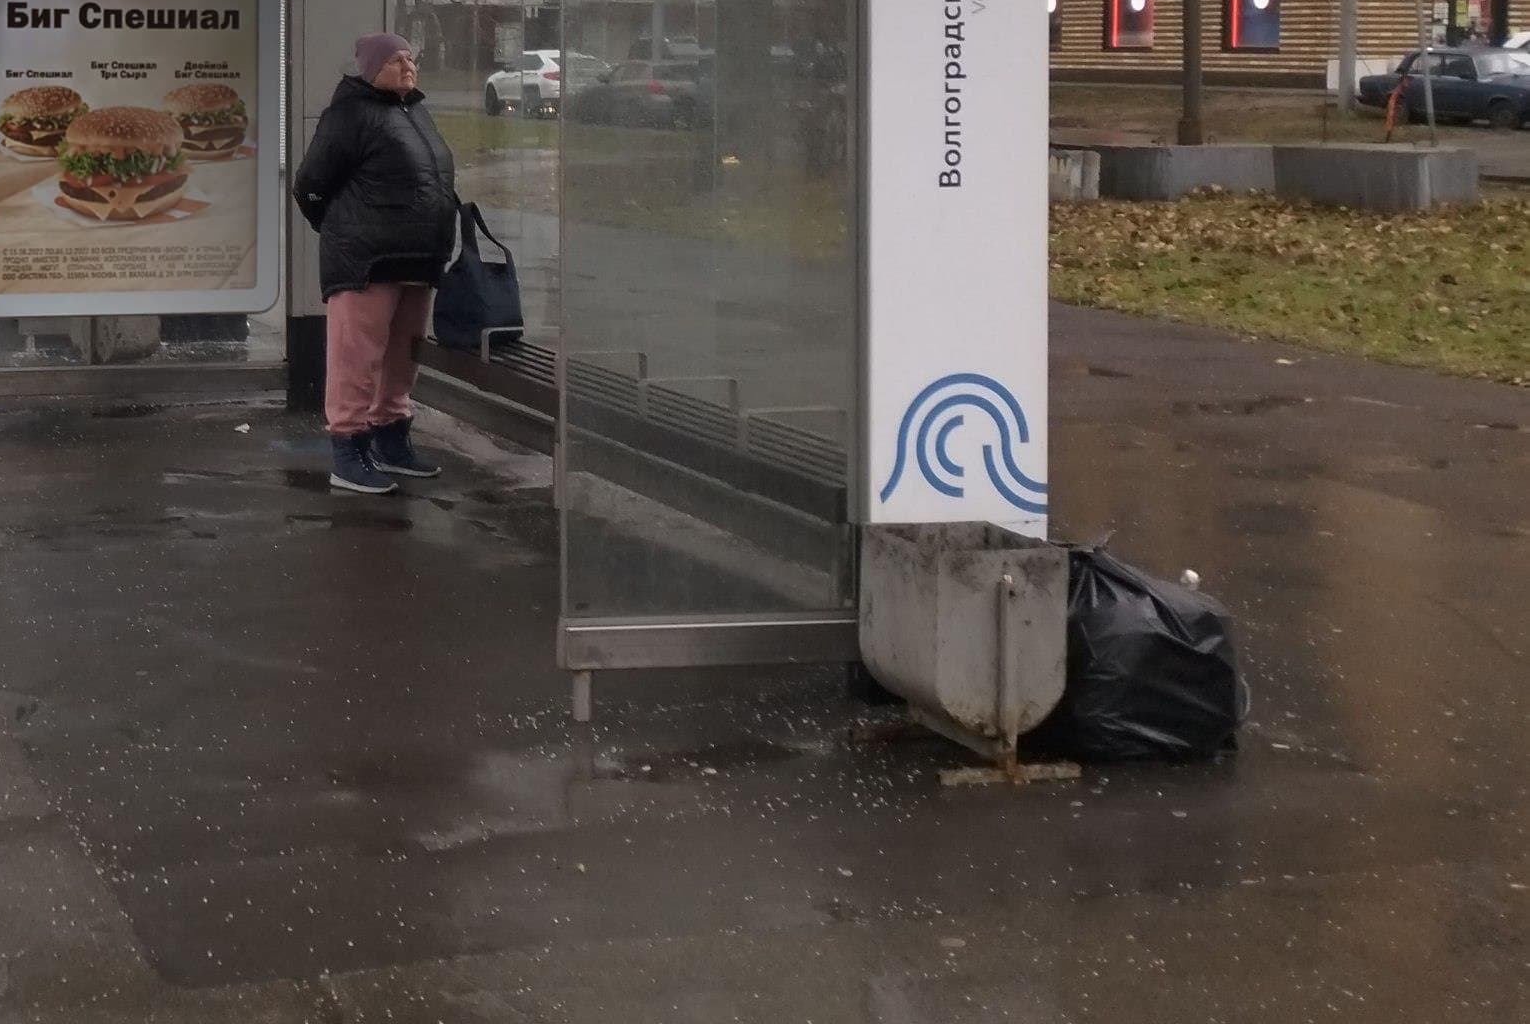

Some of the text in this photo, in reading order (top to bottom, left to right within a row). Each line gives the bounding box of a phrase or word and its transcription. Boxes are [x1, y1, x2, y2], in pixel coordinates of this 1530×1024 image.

[7, 2, 240, 30] Биг Спешиал
[91, 61, 157, 70] Биг Спешиал
[6, 70, 73, 78] Биг Спешиал
[101, 71, 147, 80] Три Сыра
[175, 70, 240, 79] Биг Спешиал
